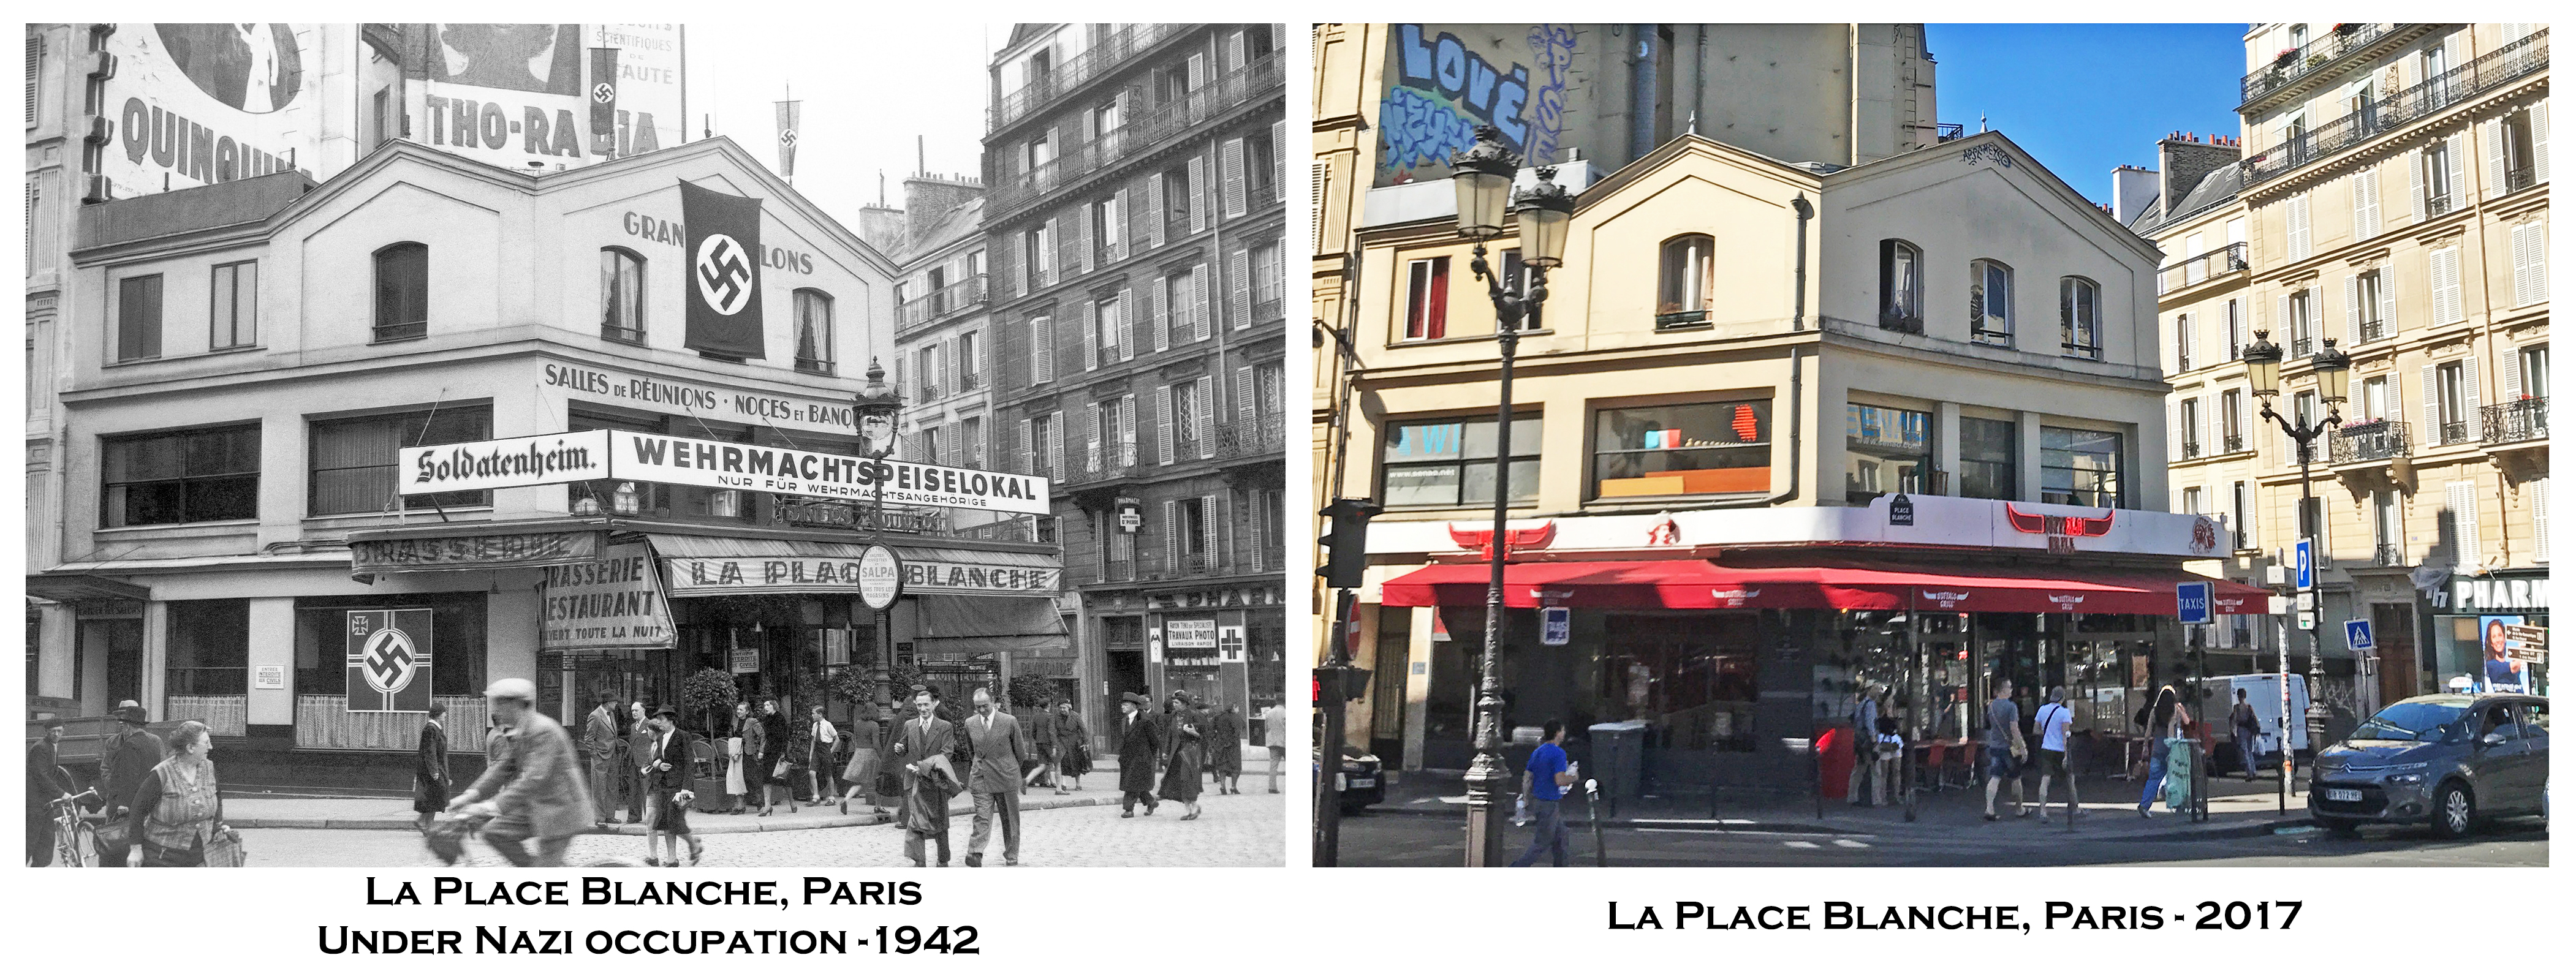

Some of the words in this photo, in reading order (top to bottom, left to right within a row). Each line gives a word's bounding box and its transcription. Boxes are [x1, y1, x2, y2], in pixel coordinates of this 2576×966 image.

[624, 211, 684, 248] GRAN
[760, 244, 814, 276] LONS
[545, 364, 610, 394] SALLES
[614, 384, 626, 398] DE
[630, 377, 716, 410] RÉUNIONS
[735, 394, 790, 420] NOCES
[794, 409, 805, 421] ET
[808, 404, 856, 429] BANQ
[634, 436, 1036, 501] WEHRMACHTSPEISELOKAL
[718, 475, 753, 487] NUR
[765, 478, 797, 491] FÜR
[808, 483, 987, 507] WEHRMACHTSANGEHÖRIGE
[549, 550, 644, 588] RASSERIE
[691, 561, 744, 586] LA
[765, 560, 859, 584] PLAC
[904, 564, 1048, 589] BLANCHE
[862, 567, 895, 578] SALPA
[2300, 549, 2307, 581] P
[548, 591, 655, 621] ESTAURANT
[2180, 598, 2205, 610] TAXIS
[544, 628, 570, 641] VERT
[575, 627, 607, 640] TOUTE
[613, 626, 626, 638] LA
[633, 625, 662, 638] NUIT
[1169, 630, 1193, 640] TRAVAUX
[1195, 630, 1214, 640] PHOTO
